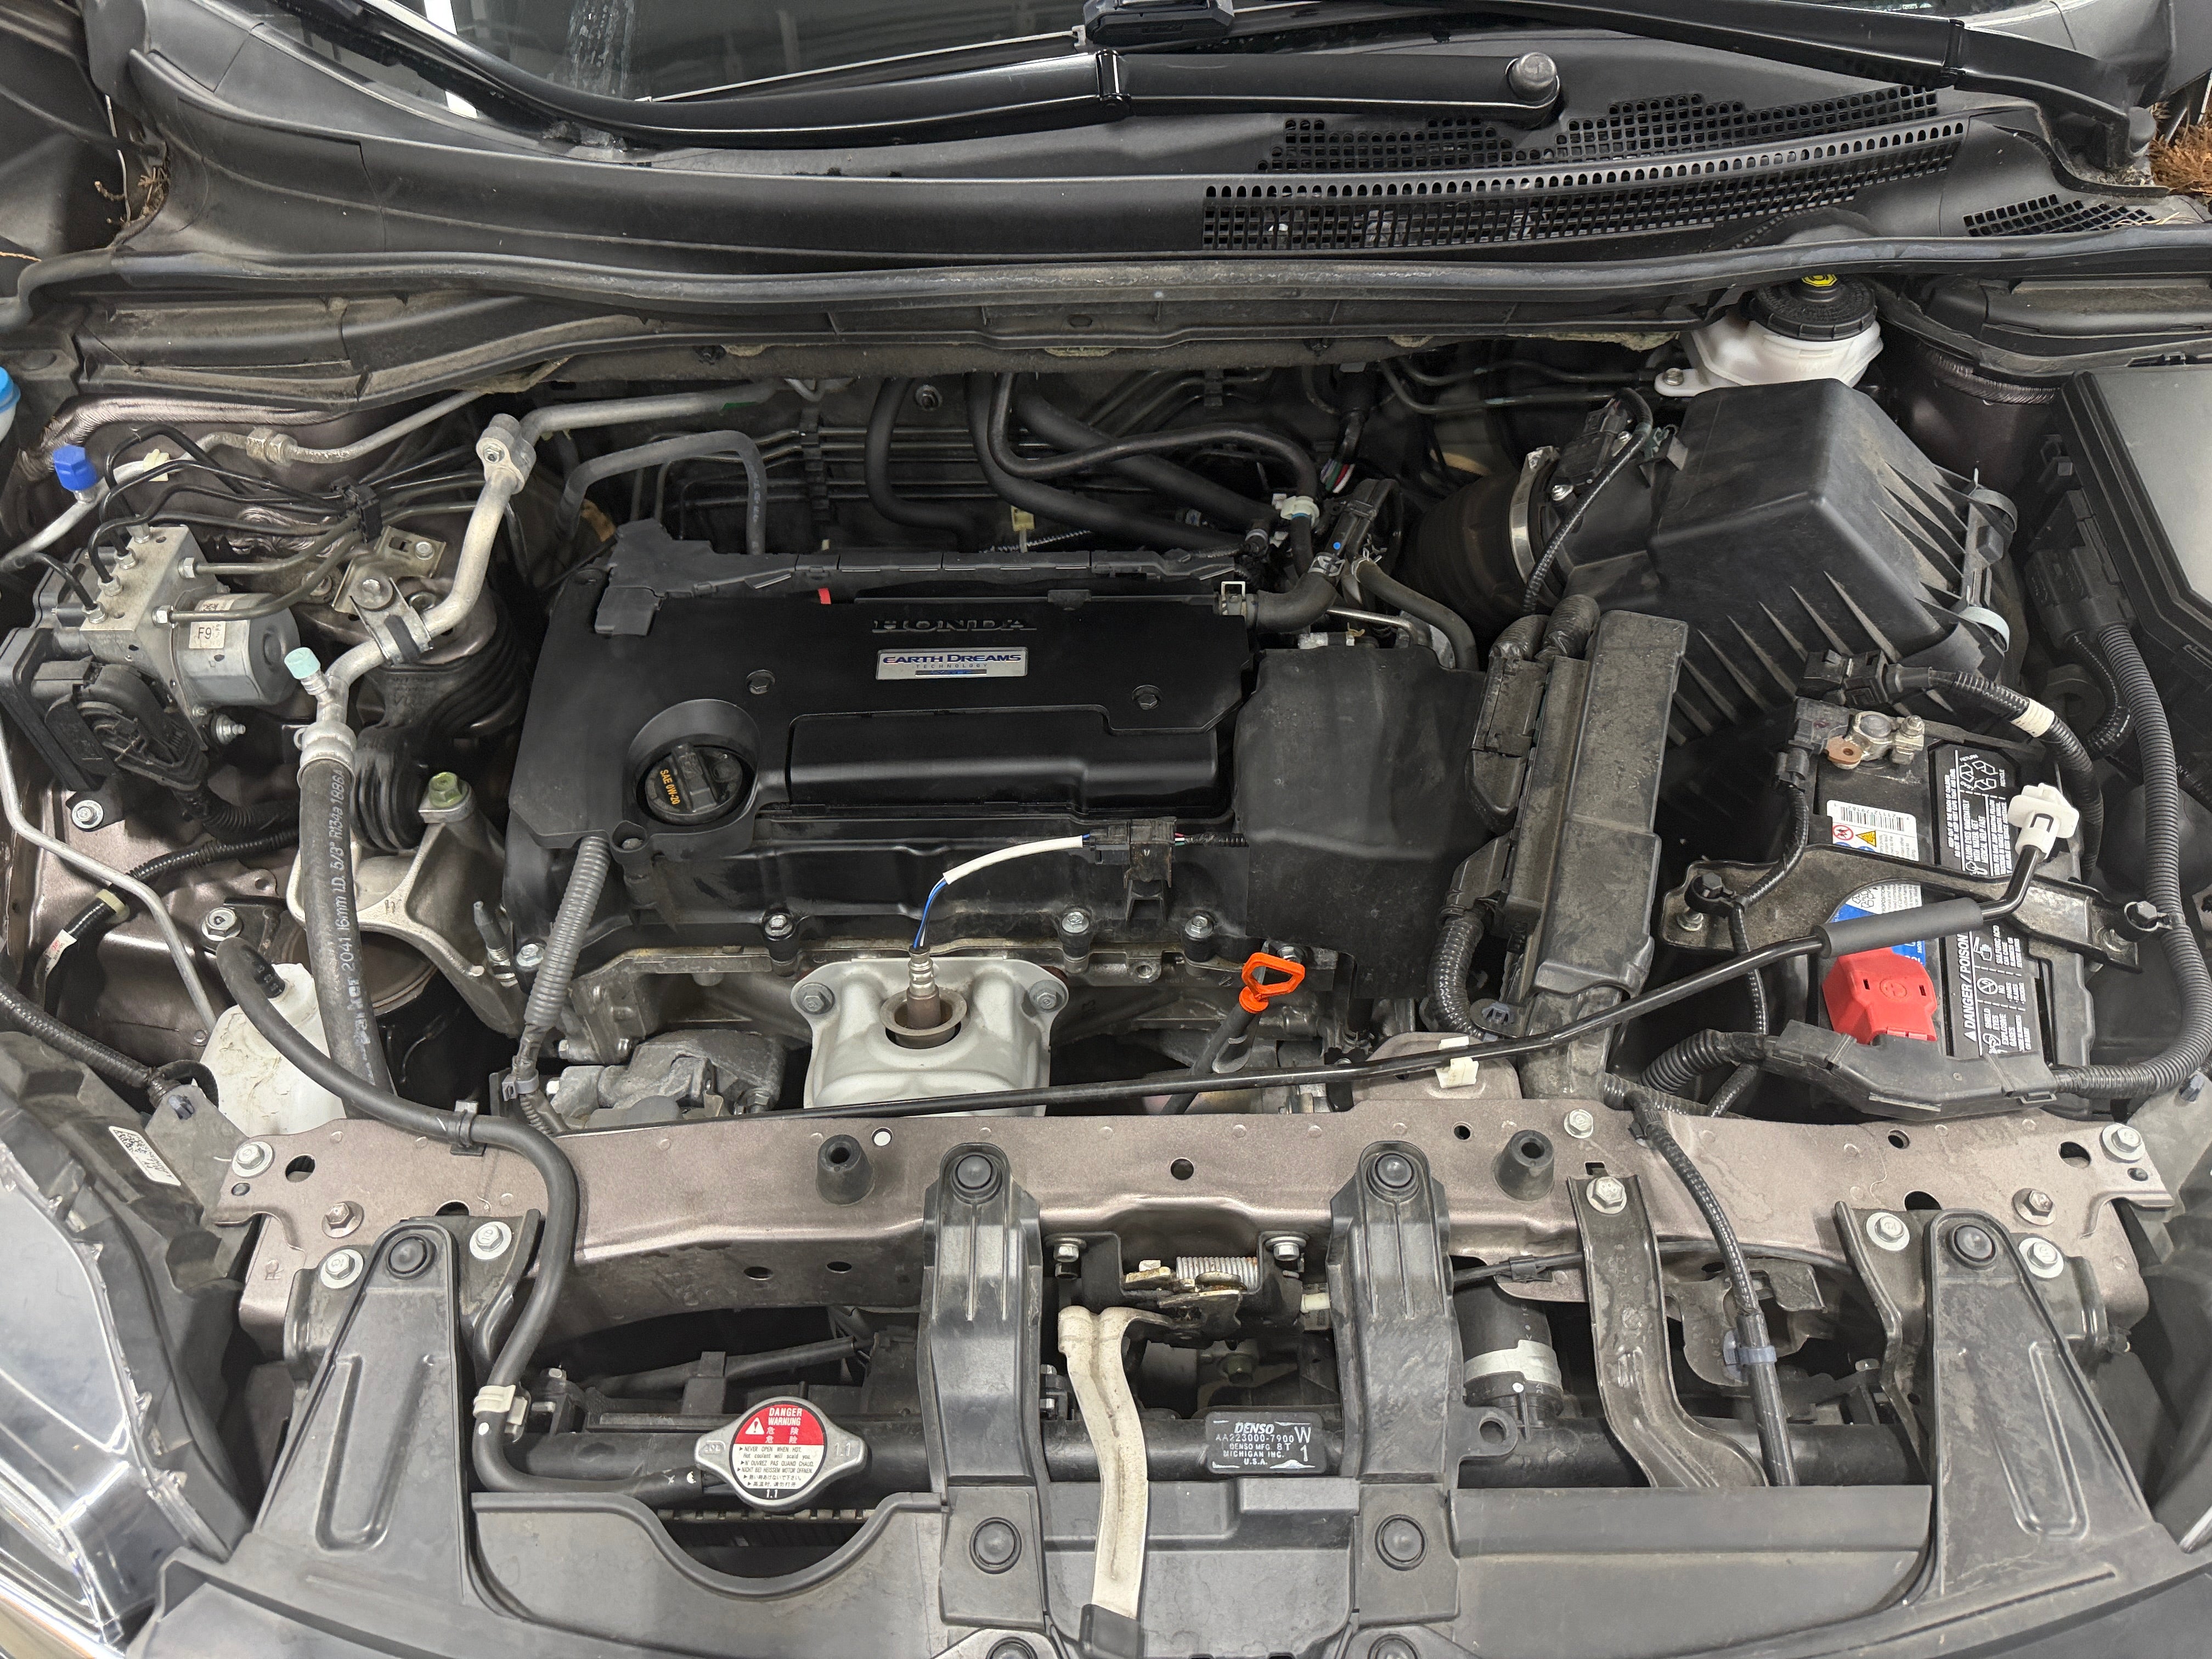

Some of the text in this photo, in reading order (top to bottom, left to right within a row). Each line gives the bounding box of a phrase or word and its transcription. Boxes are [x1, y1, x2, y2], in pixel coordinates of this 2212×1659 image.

[198, 627, 212, 639] F9
[872, 619, 1037, 633] HONDA
[883, 654, 1022, 664] EARTH DREAMS
[1959, 754, 1979, 762] RETURN
[660, 769, 673, 785] SAE
[665, 783, 681, 805] 0W-20
[329, 806, 343, 840] R134a
[1962, 799, 1973, 860] FLUSH EYES IMMEDIATELY
[1978, 815, 1988, 864] MEDICAL HELP FAST
[333, 896, 351, 930] 16mm
[337, 938, 356, 972] 2041
[1994, 938, 2003, 964] SULFURIC
[1997, 985, 2005, 994] NO
[1983, 1008, 1992, 1029] SHIELD
[1991, 1015, 2000, 1030] EYES
[1999, 1014, 2009, 1045] EXPLOSIVE
[2008, 1027, 2017, 1047] GASES
[769, 1408, 803, 1417] DANGER
[768, 1417, 801, 1426] WARNUNG
[1234, 1422, 1274, 1434] DENSO
[1215, 1434, 1294, 1443] AA223000-7900
[1294, 1426, 1311, 1443] W
[835, 1442, 851, 1457] 1.1
[1300, 1444, 1308, 1462] 1
[766, 1489, 778, 1498] 1.1
